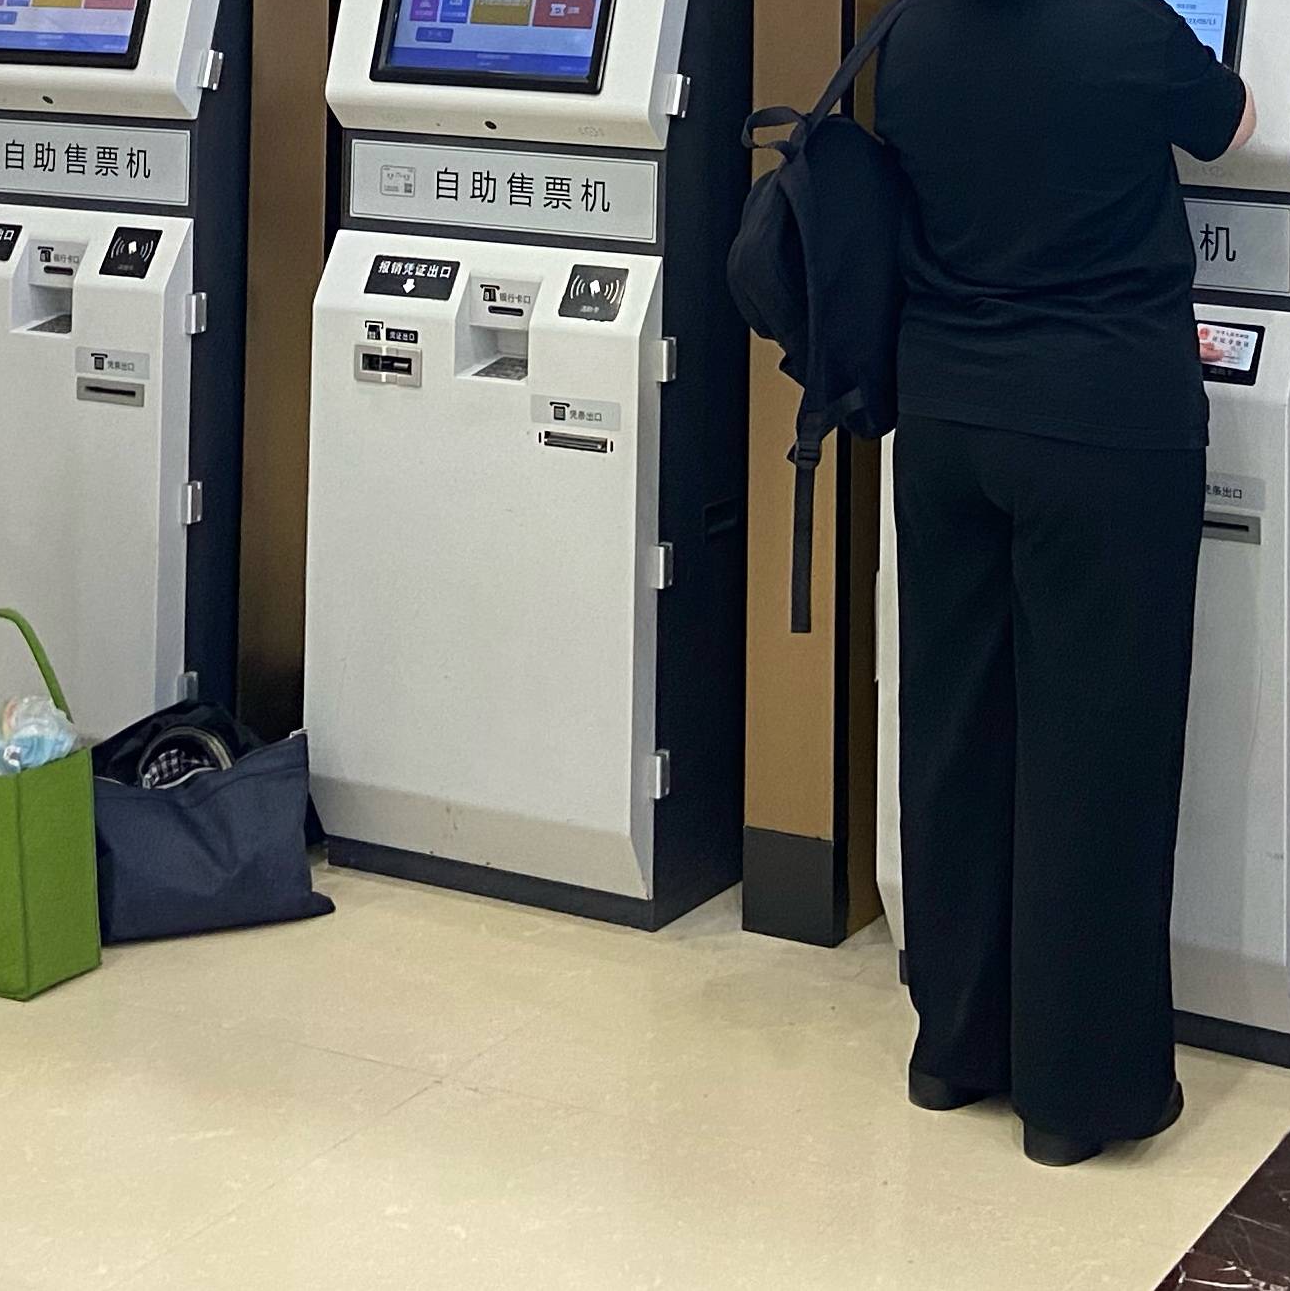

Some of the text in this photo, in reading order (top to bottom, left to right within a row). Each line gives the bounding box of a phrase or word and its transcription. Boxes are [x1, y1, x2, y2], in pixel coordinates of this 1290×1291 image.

[4, 139, 151, 179] 自助售票机
[435, 167, 610, 212] 自助售票机
[1199, 224, 1236, 262] 机
[378, 260, 451, 279] 报销凭证出口
